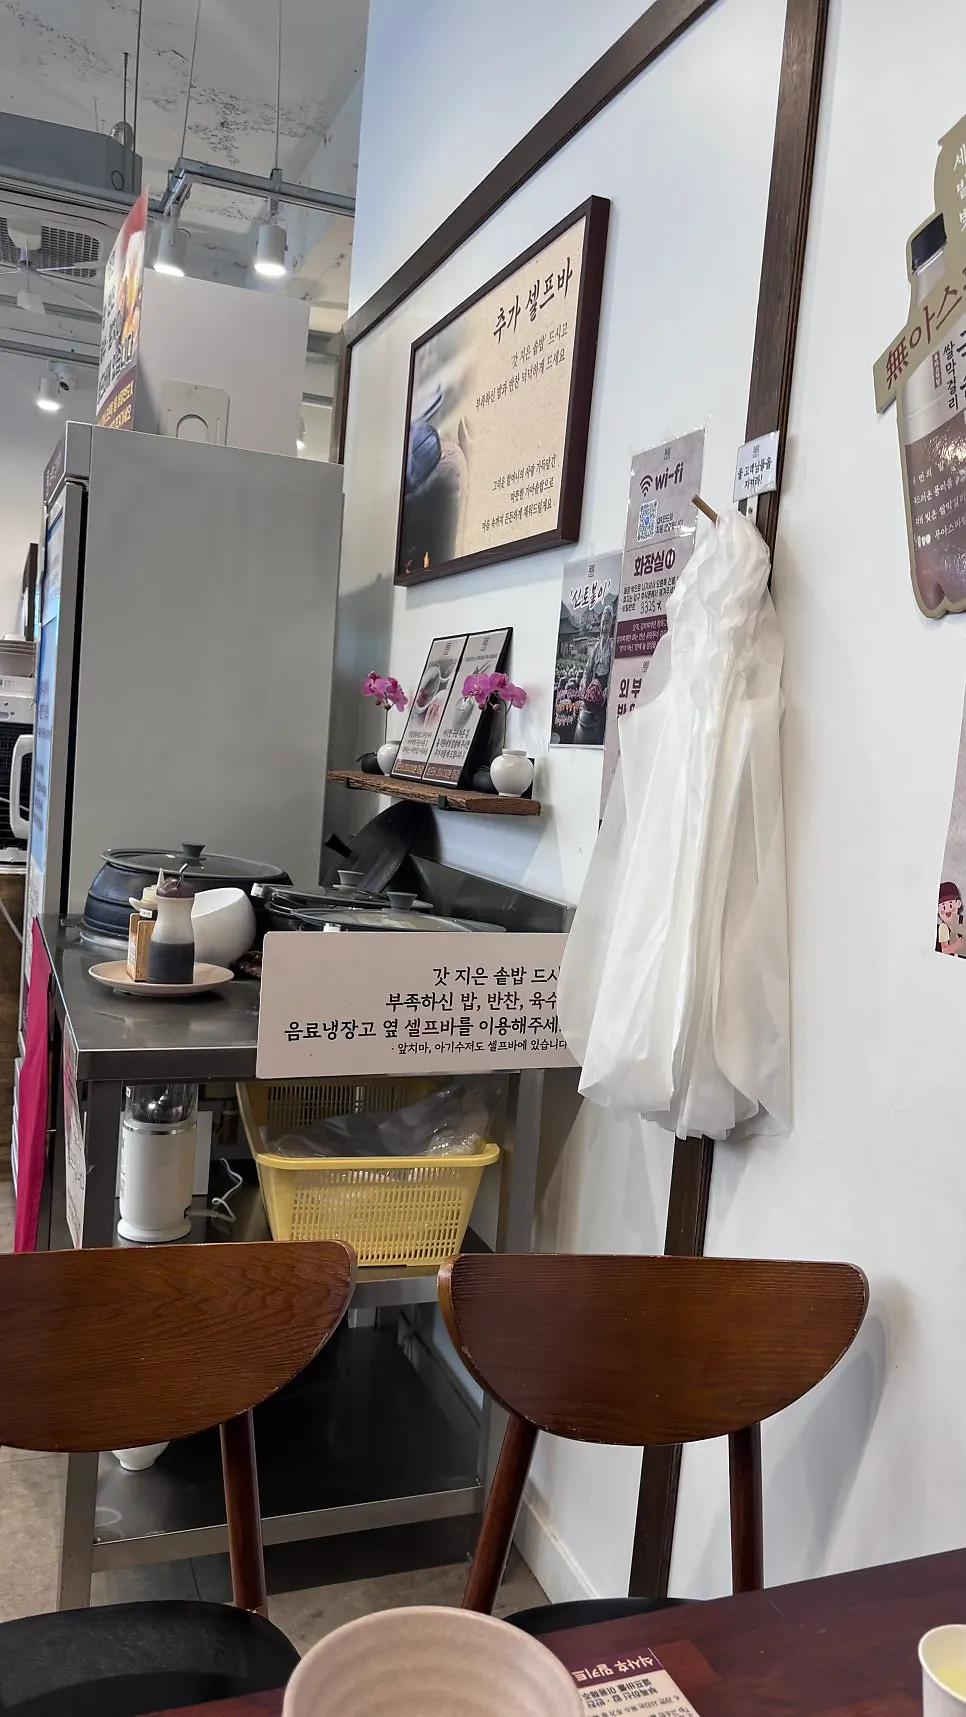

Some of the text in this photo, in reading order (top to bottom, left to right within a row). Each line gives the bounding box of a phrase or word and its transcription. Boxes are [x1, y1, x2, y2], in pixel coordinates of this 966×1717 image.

[494, 257, 572, 344] 추가 셀프바
[548, 322, 568, 345] 드시고
[476, 388, 495, 410] 부족하신
[522, 358, 544, 384] 넉넉하게
[546, 348, 565, 370] 드세요
[943, 340, 958, 410] 쌀막걸리
[655, 462, 684, 491] wi-fi
[634, 549, 664, 577] 화장실
[619, 678, 642, 698] 외부
[432, 966, 450, 986] 갓
[455, 966, 488, 984] 지은
[492, 966, 527, 986] 솥밥
[386, 992, 453, 1012] 부족하신
[460, 992, 481, 1012] 밥,
[487, 992, 524, 1011] 반찬,
[284, 1016, 562, 1042] 음료냉장고 옆 셀프바를 이용해주세
[397, 1042, 431, 1054] 앞치마,
[434, 1040, 484, 1053] 아기수저도
[488, 1039, 528, 1052] 셀프바에
